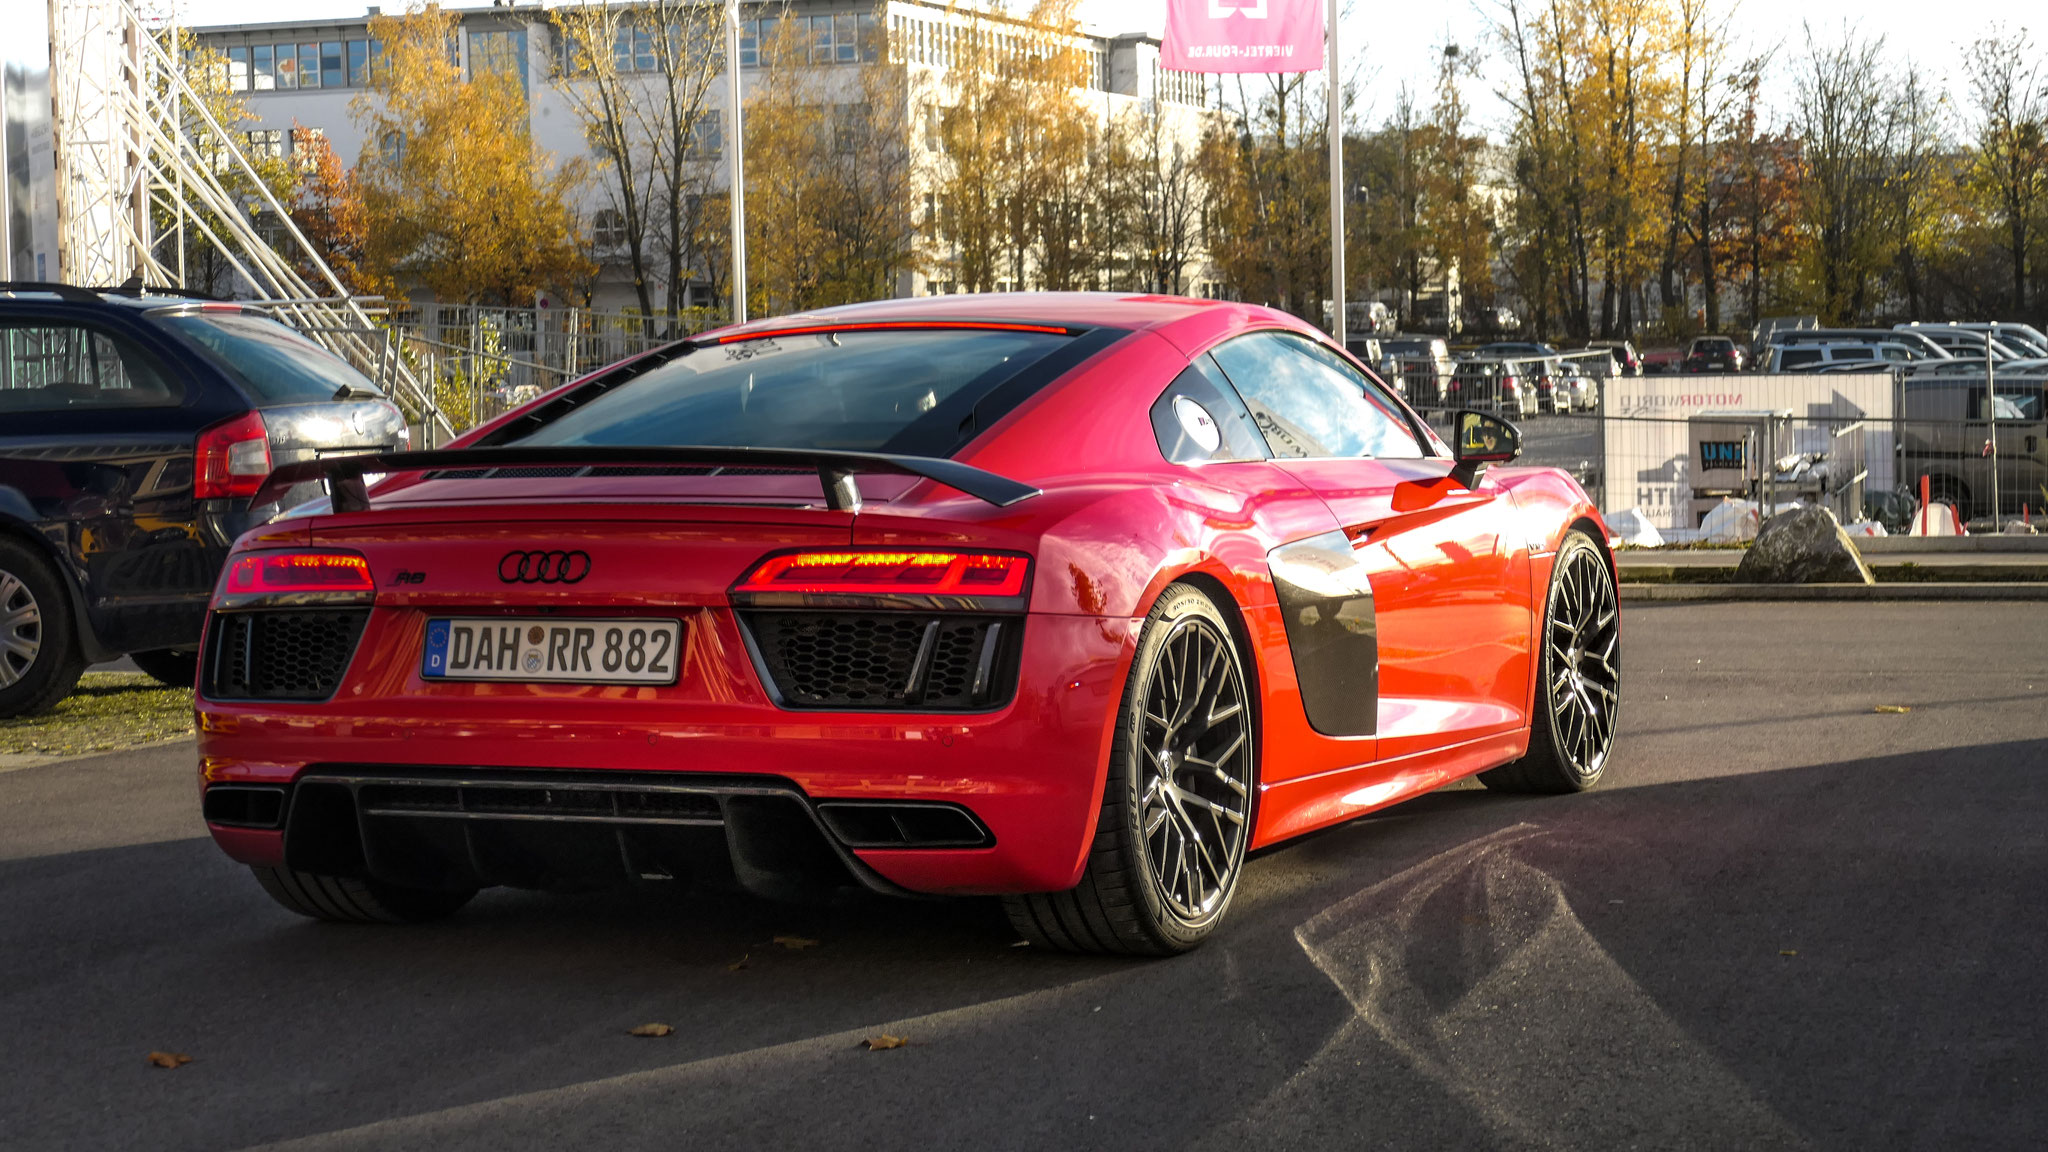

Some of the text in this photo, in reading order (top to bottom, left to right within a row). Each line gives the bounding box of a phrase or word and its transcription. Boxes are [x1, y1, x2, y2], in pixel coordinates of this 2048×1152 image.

[393, 571, 426, 585] R8
[450, 627, 672, 673] DAH RR 882
[431, 654, 440, 667] D
